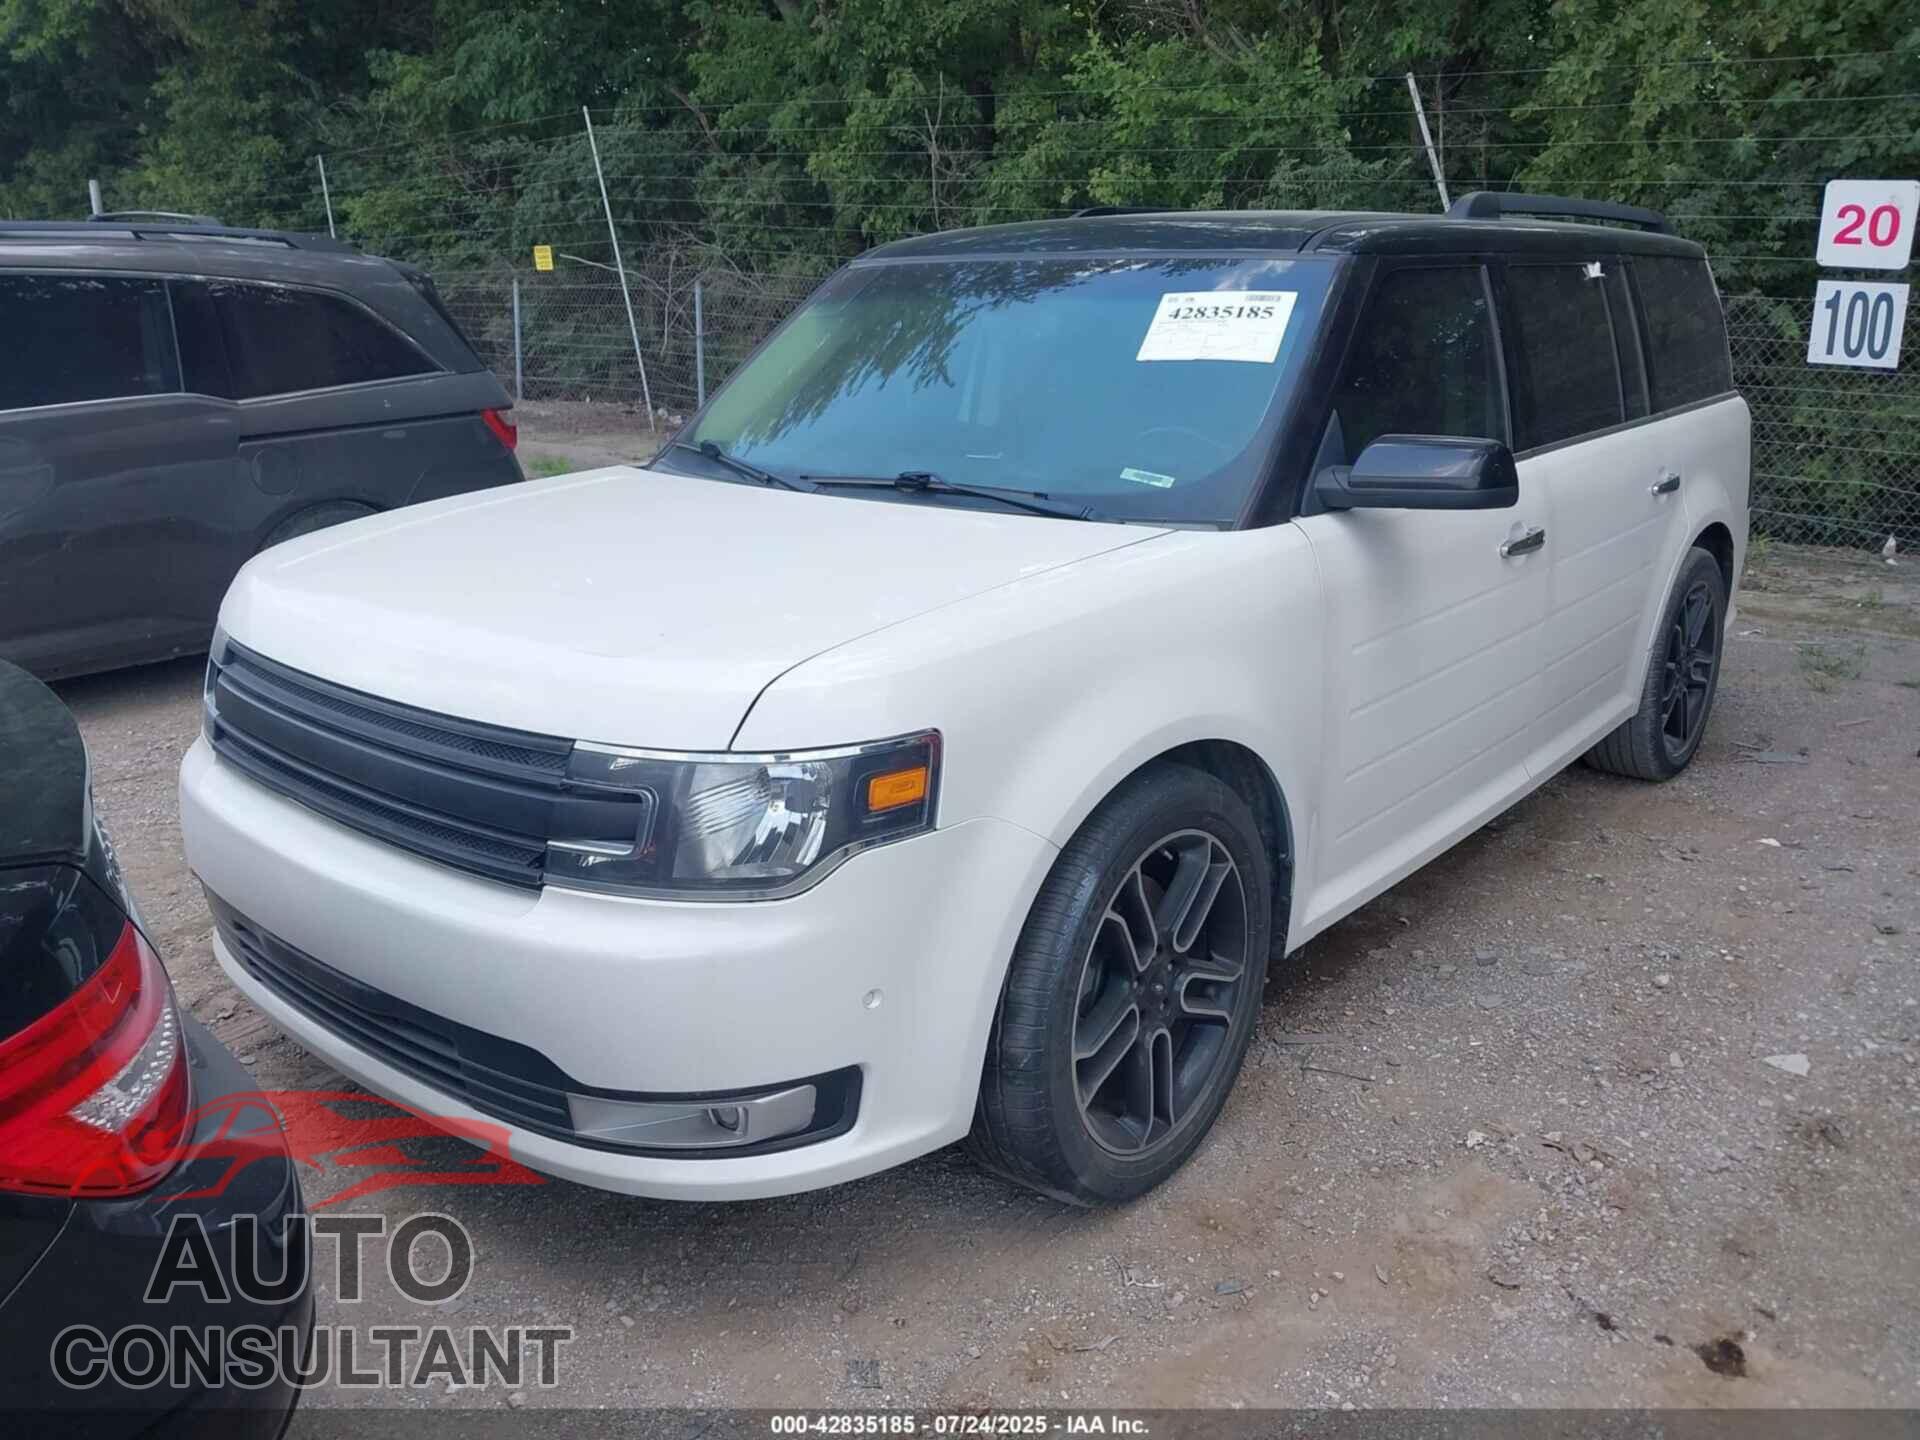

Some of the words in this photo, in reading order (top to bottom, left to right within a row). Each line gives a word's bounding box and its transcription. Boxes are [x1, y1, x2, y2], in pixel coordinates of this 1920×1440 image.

[1833, 204, 1901, 247] 20
[1168, 305, 1275, 320] 42835185
[1824, 289, 1894, 360] 100
